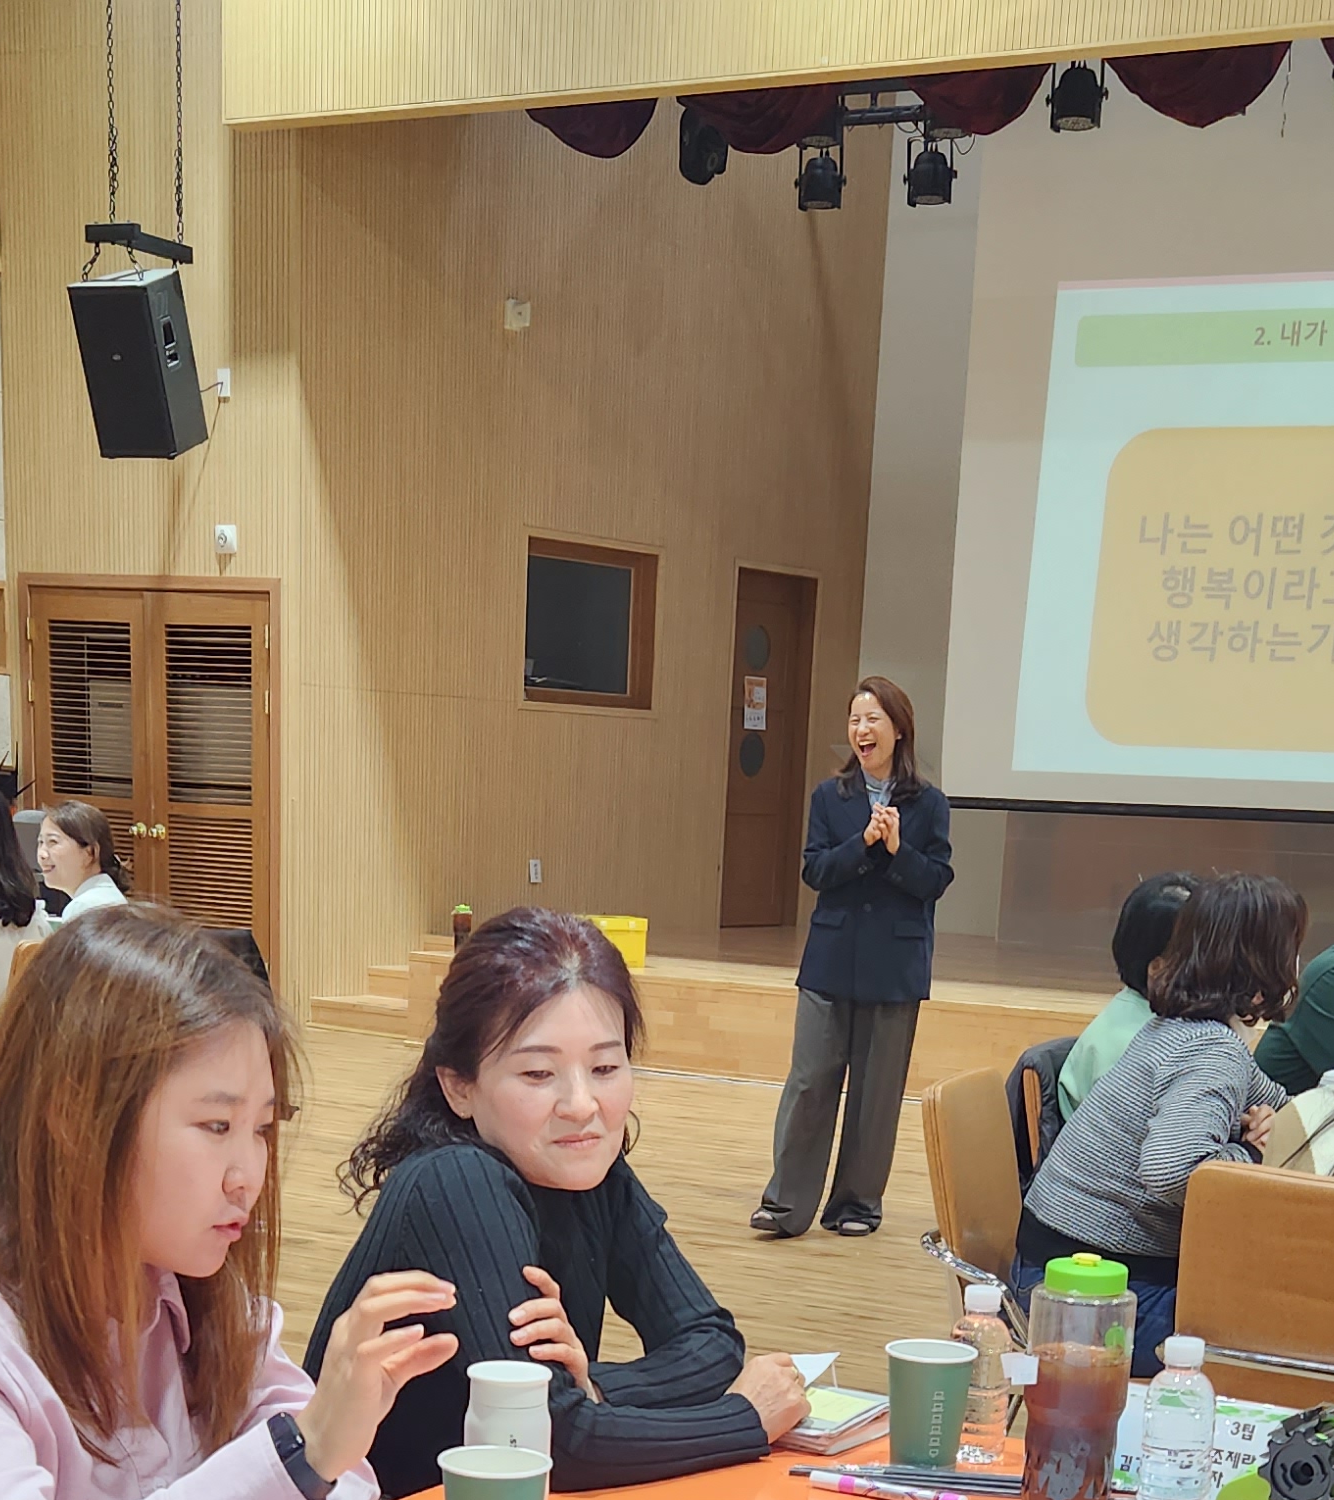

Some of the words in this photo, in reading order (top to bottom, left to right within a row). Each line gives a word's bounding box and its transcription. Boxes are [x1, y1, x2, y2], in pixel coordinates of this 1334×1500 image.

[1254, 326, 1272, 346] 2.
[1280, 320, 1327, 347] 내가
[1138, 512, 1214, 555] 나는
[1228, 512, 1305, 557] 어떤
